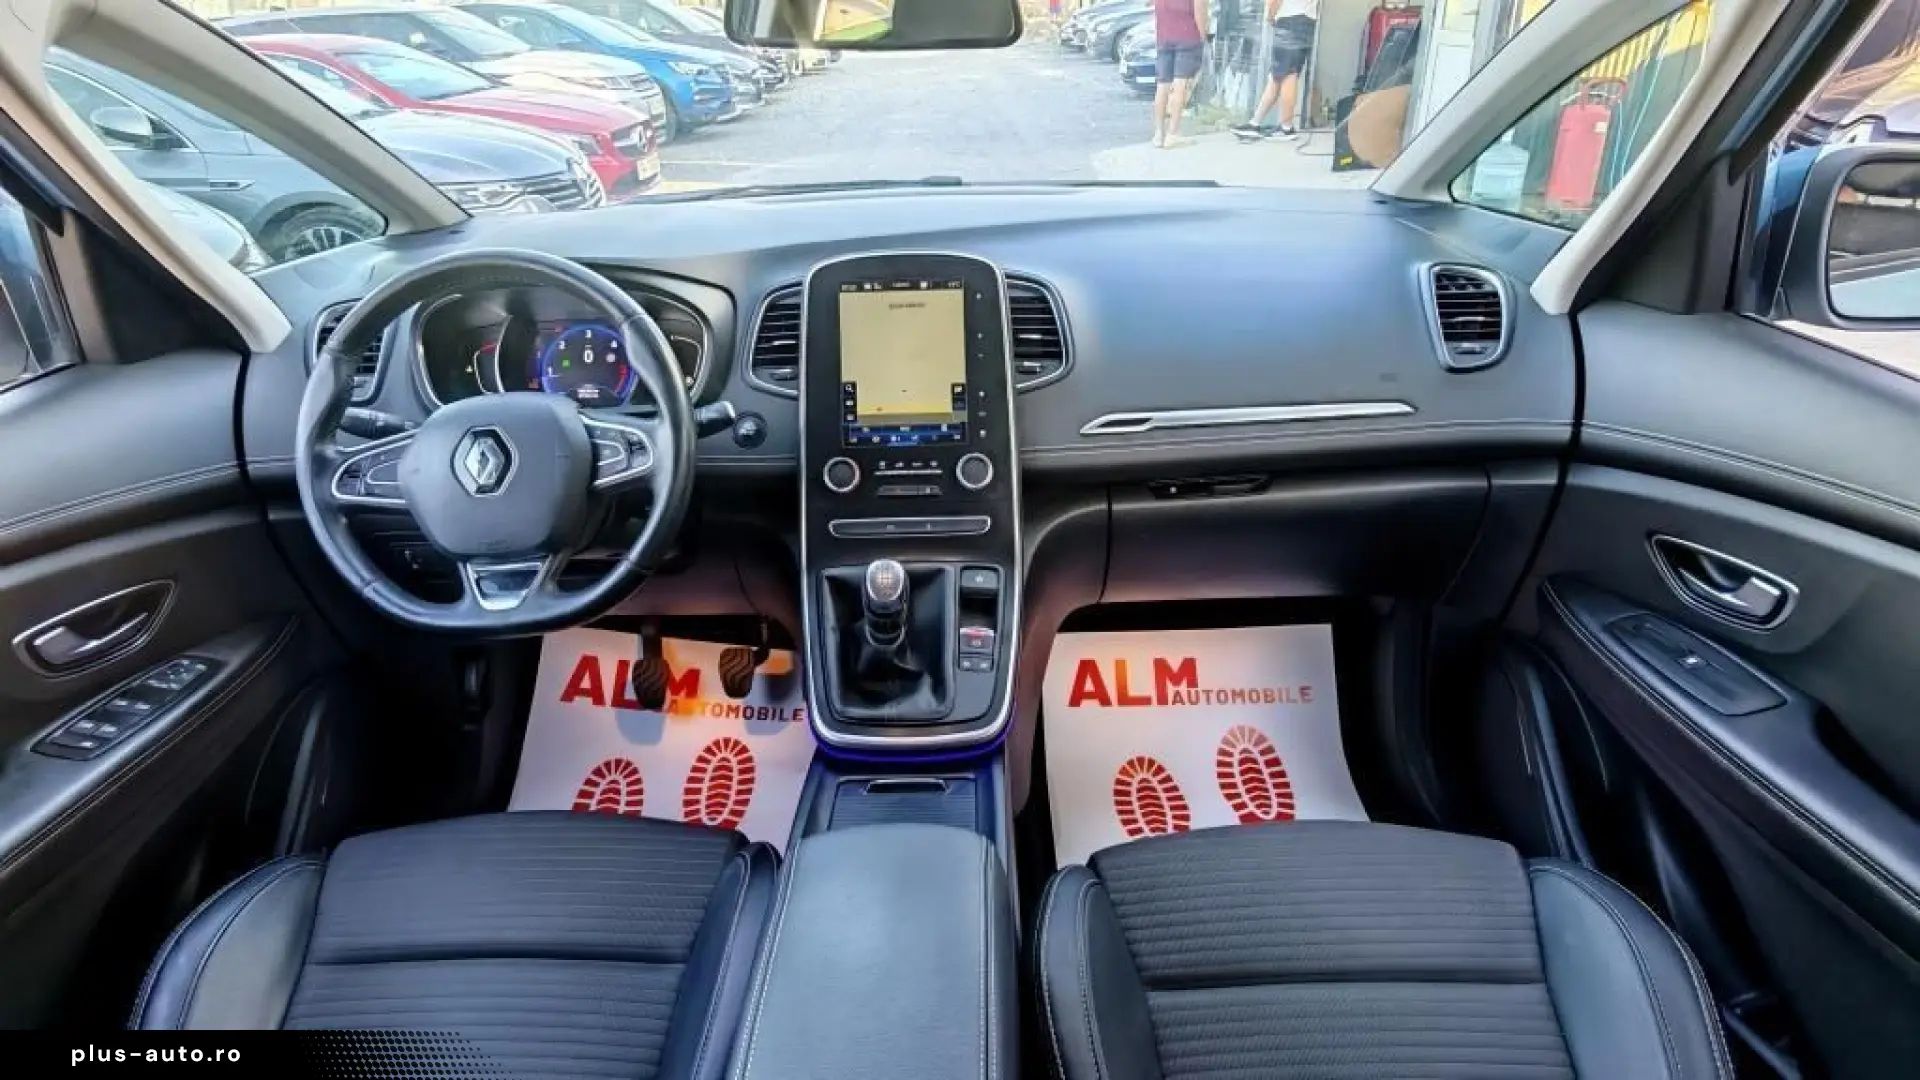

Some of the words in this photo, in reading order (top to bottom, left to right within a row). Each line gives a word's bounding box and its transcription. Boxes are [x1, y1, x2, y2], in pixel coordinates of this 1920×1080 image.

[1068, 657, 1199, 707] ALM
[1171, 686, 1313, 706] AUTOMOBILE
[668, 698, 804, 721] ATOMOBILE
